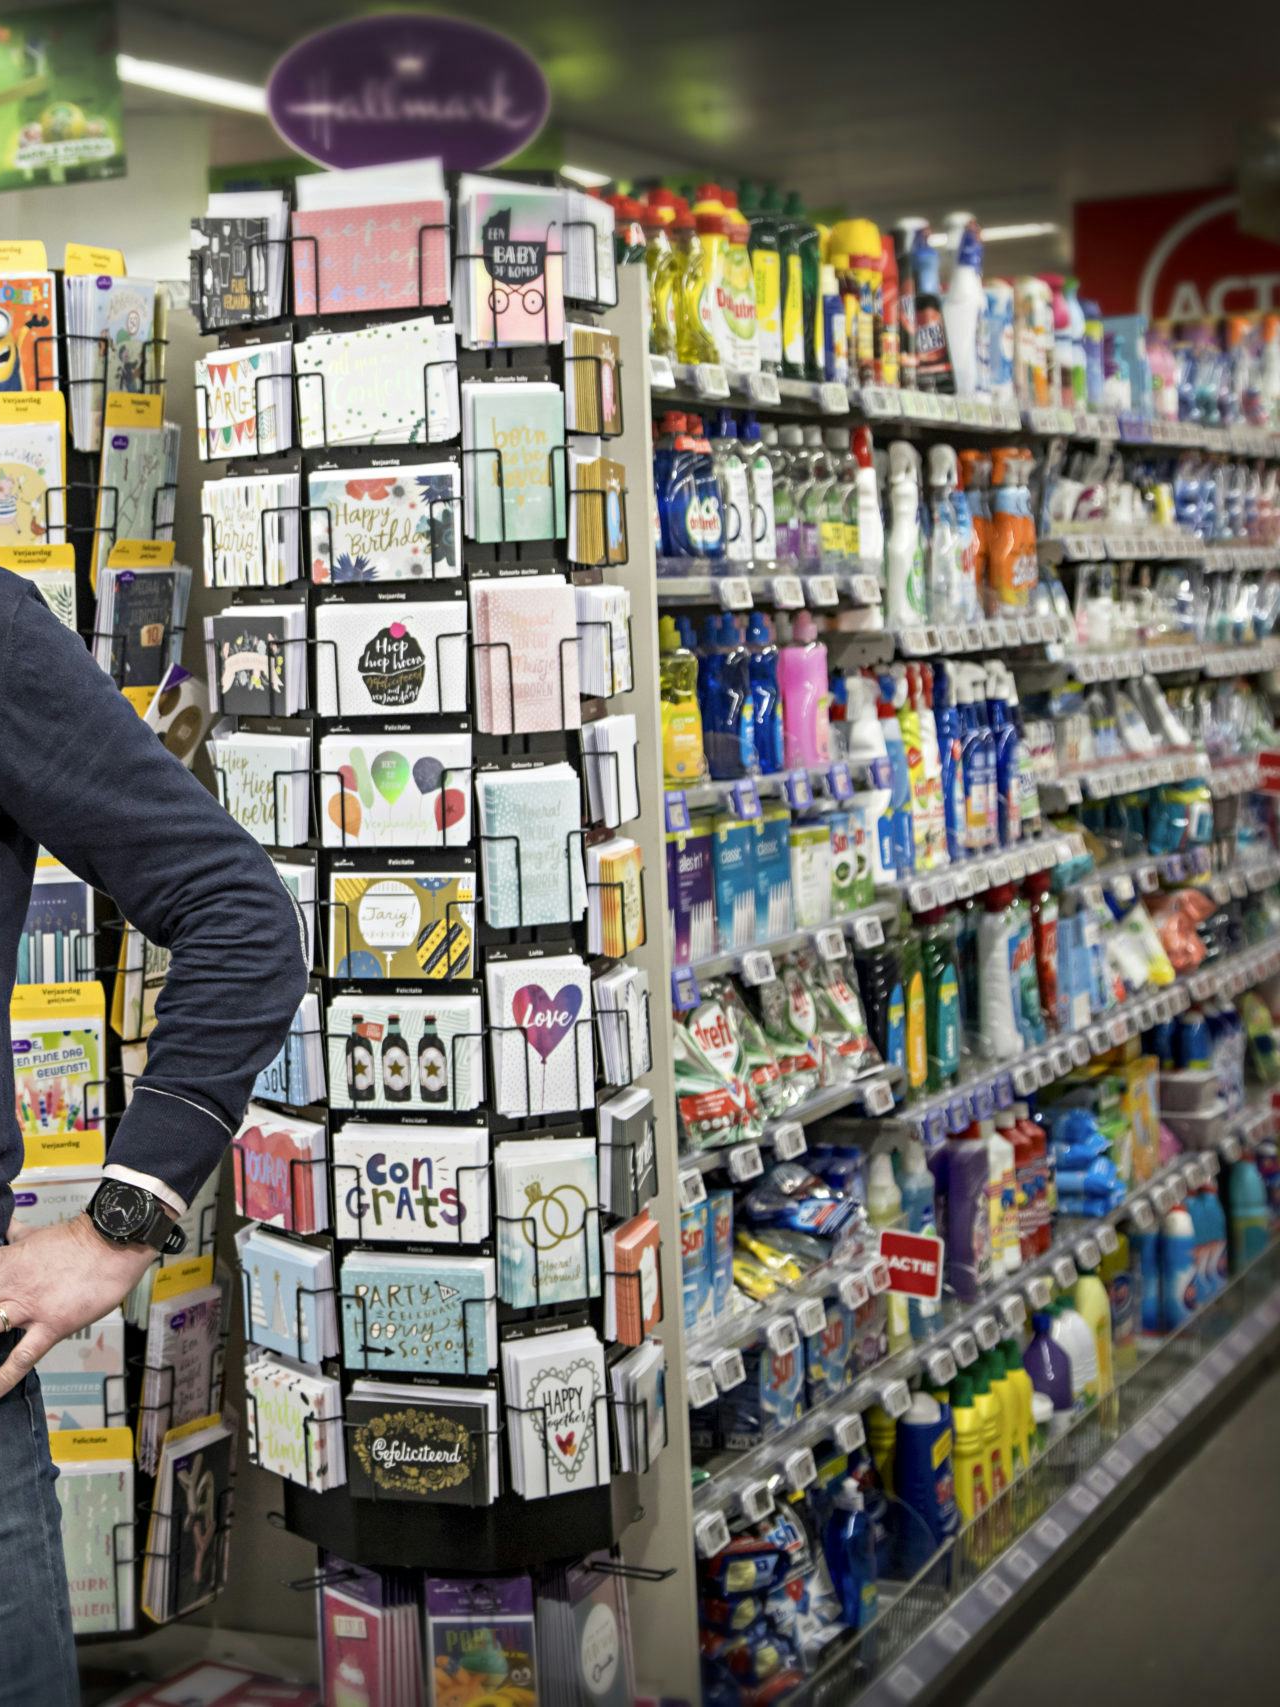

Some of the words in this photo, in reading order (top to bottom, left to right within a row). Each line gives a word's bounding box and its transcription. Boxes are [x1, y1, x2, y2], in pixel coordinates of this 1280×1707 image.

[488, 227, 506, 242] EEN
[492, 245, 541, 265] BABY
[327, 501, 394, 531] Happy
[375, 636, 409, 660] Hiep
[364, 650, 390, 673] hiep
[392, 652, 423, 671] hoera
[832, 832, 849, 855] Sun
[42, 987, 81, 996] Verjaardag
[523, 1003, 573, 1029] Love
[695, 1014, 733, 1051] dreft
[63, 1048, 83, 1060] DAG
[36, 1062, 89, 1079] GEWENST!
[41, 1139, 80, 1149] Verjaardag
[680, 1228, 704, 1256] Sun
[888, 1255, 937, 1277] ACTIE
[543, 1385, 583, 1416] HAPPY
[371, 1437, 462, 1469] Gefeliciteerd
